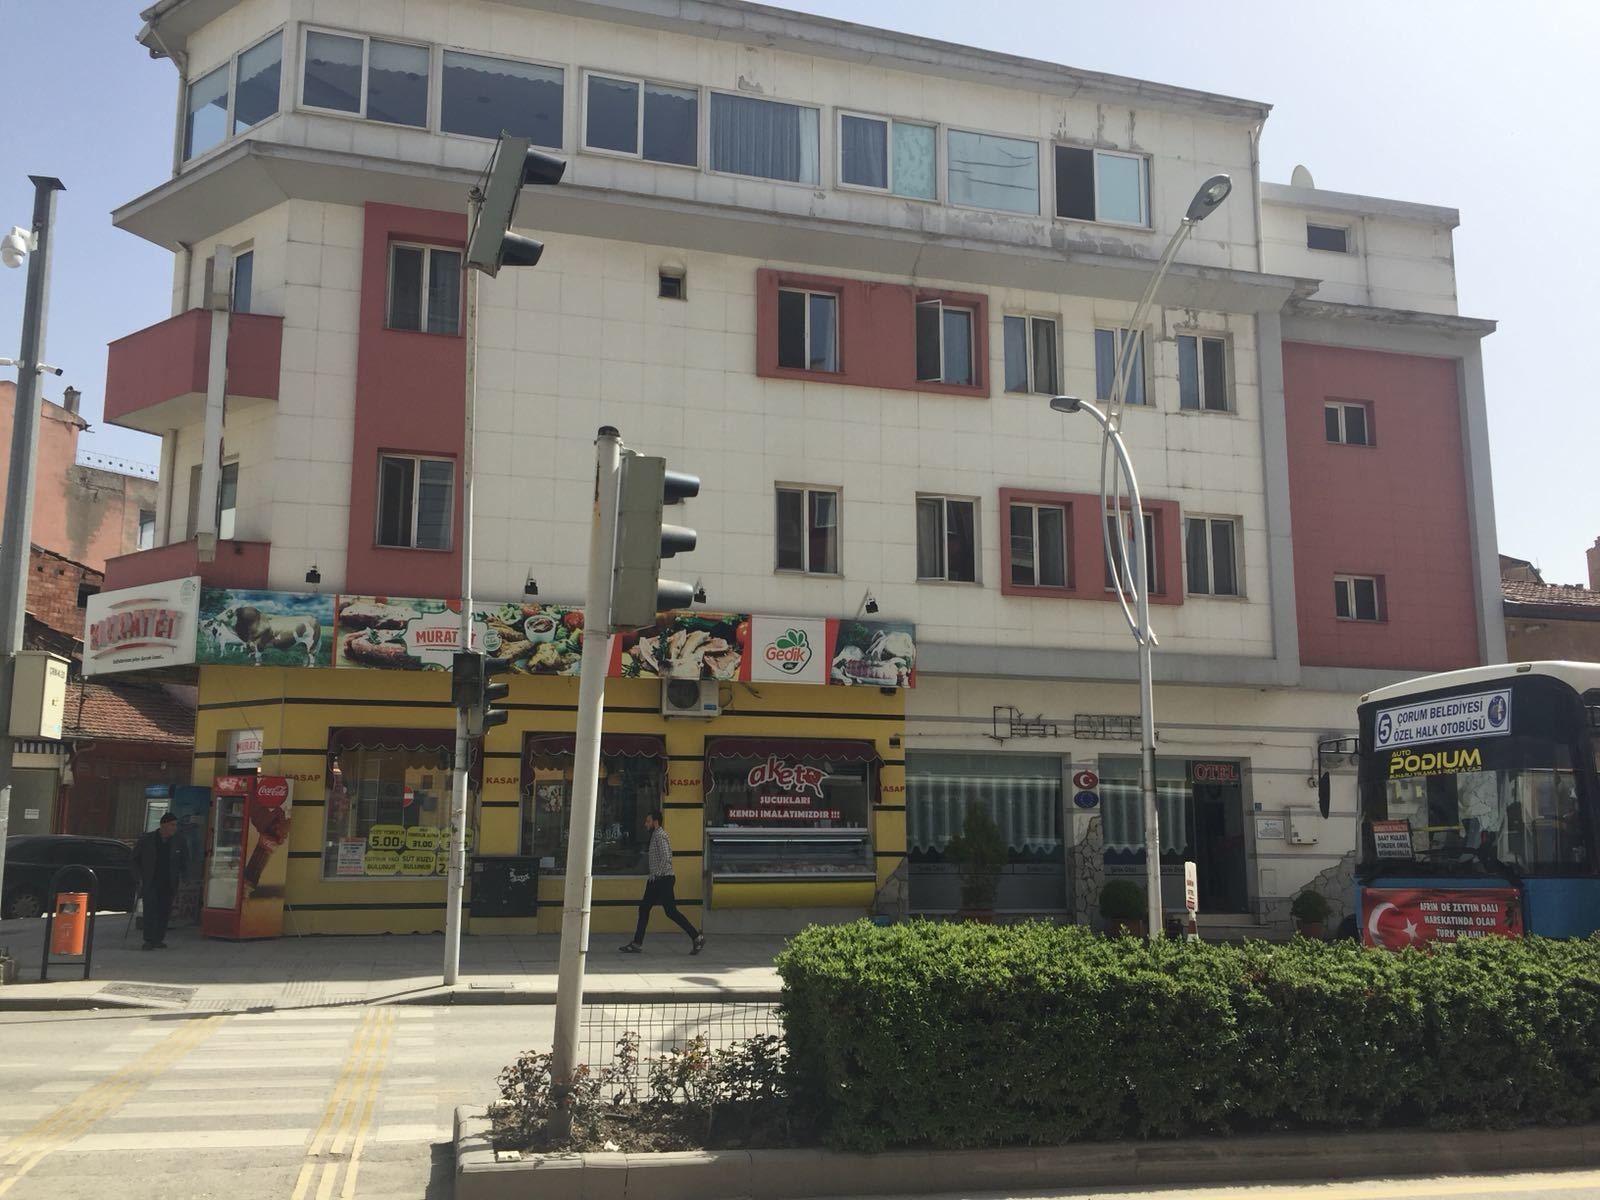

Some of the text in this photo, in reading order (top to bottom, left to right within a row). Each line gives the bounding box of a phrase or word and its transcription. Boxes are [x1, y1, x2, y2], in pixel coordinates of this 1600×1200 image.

[416, 631, 458, 644] MURAT
[766, 646, 805, 663] Gedik
[1398, 697, 1483, 726] ÇORUM BELEDİYESİ
[1380, 718, 1391, 738] 5
[1394, 715, 1486, 742] ÖZEL HALK OTOBÜSÜ
[1392, 749, 1411, 757] AUTO
[1390, 748, 1482, 774] PODIUM
[1194, 764, 1239, 781] OTEL
[486, 776, 519, 785] KASAP
[884, 785, 905, 793] ASAP
[760, 796, 811, 805] SUCUKLARI
[1441, 904, 1451, 912] DE
[1481, 904, 1499, 913] DALI
[1424, 915, 1496, 926] HAREKATINDA OLAN
